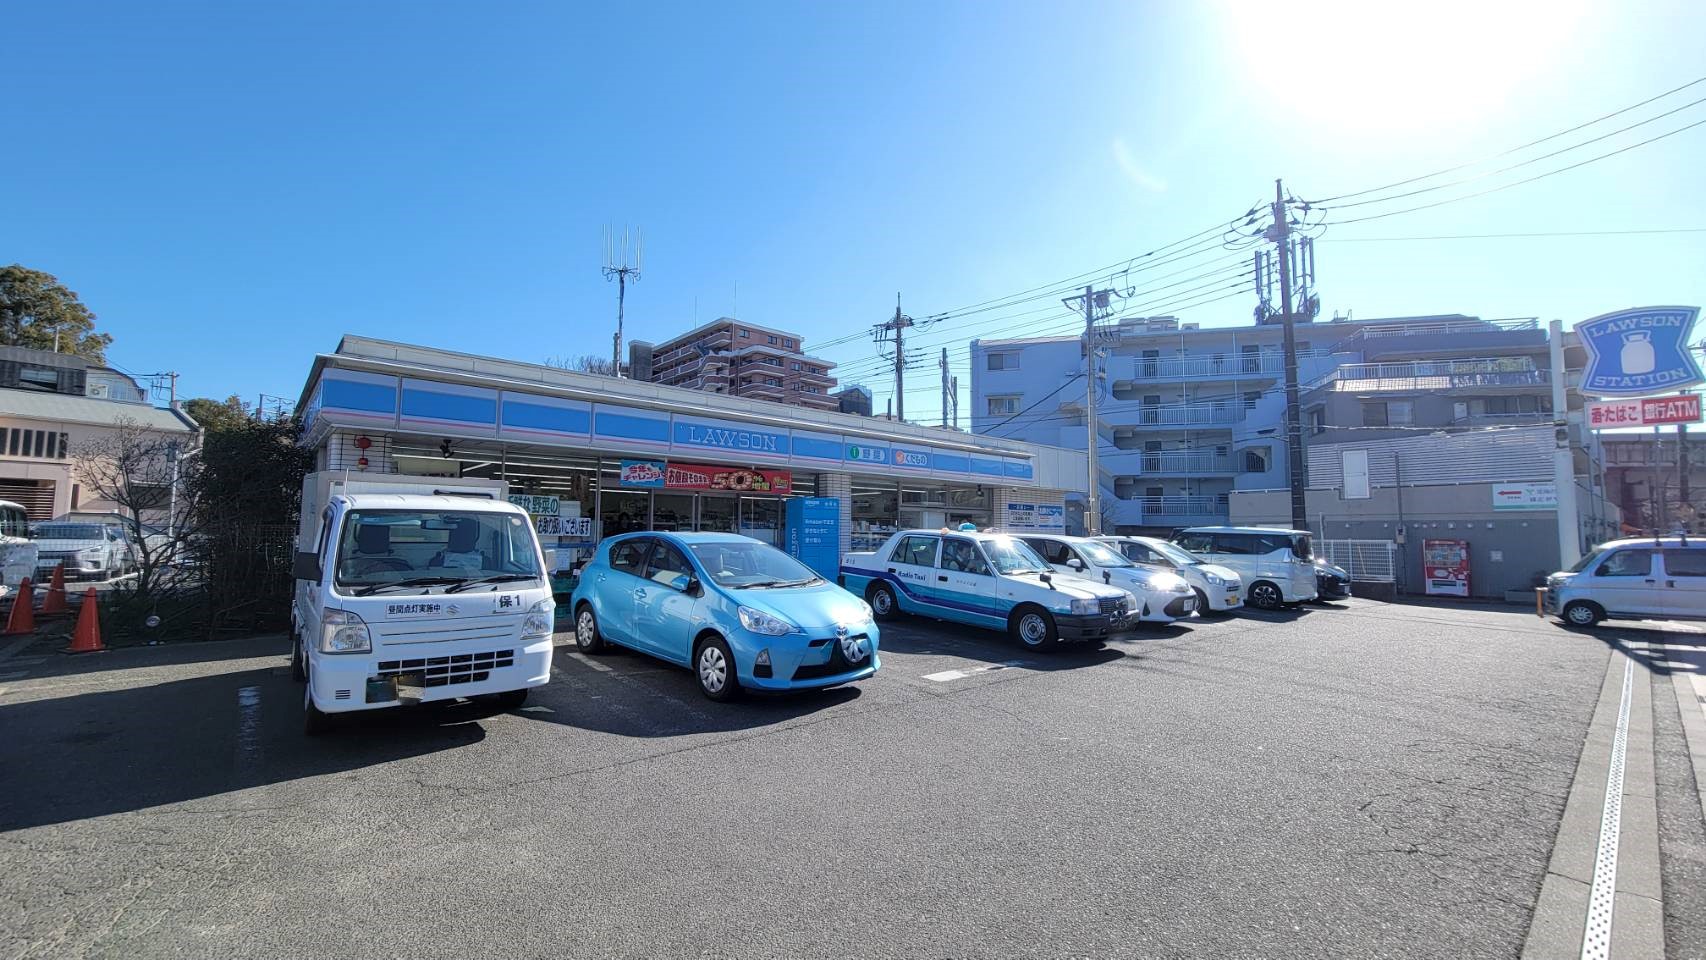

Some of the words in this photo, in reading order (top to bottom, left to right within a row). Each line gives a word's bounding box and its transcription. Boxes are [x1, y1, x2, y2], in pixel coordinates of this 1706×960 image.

[1590, 315, 1683, 338] LAWSON
[1593, 367, 1687, 387] STATION
[1644, 400, 1698, 420] 銀行ATM
[688, 426, 777, 451] LAWSON
[914, 573, 927, 582] Taxi
[387, 603, 441, 615] 昼間点灯実施中
